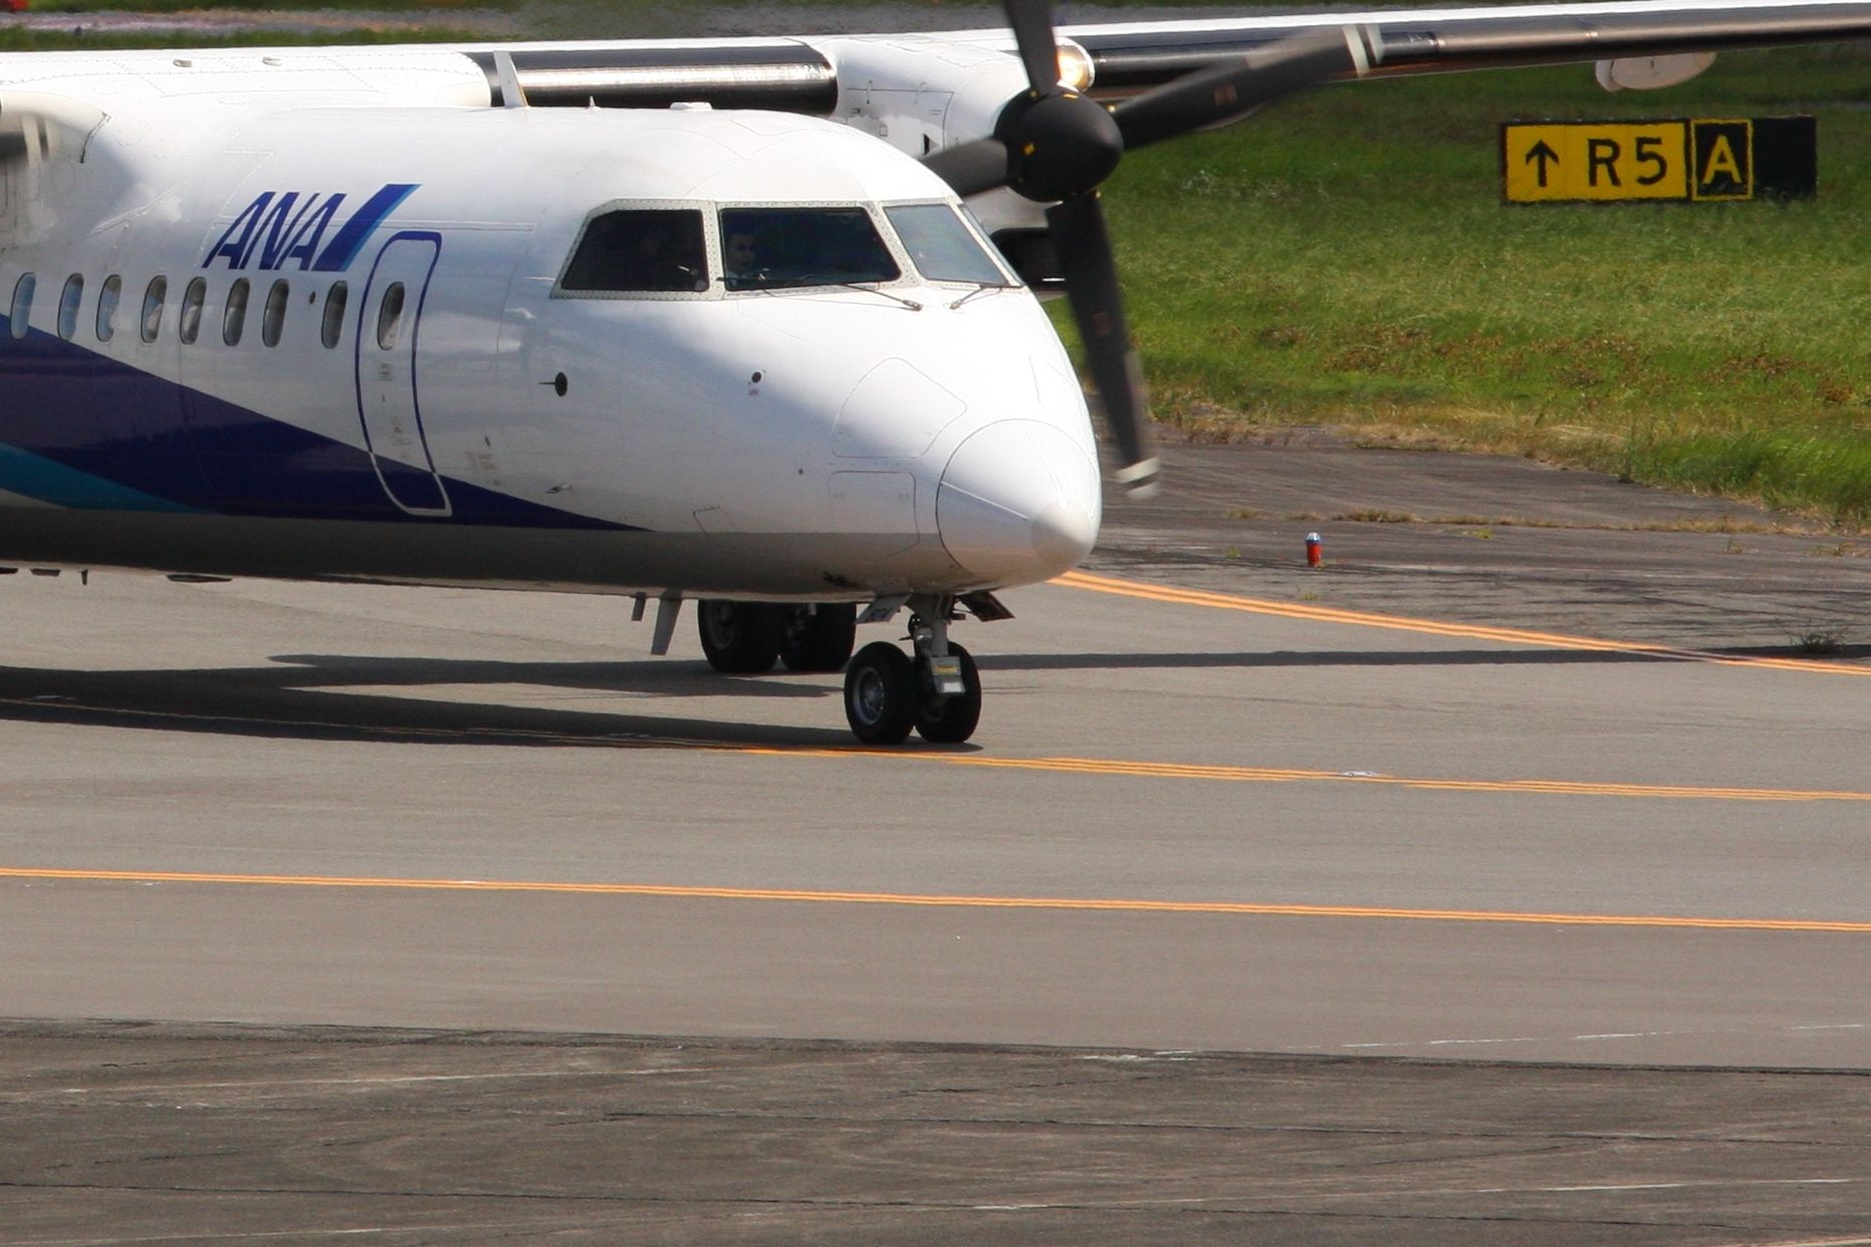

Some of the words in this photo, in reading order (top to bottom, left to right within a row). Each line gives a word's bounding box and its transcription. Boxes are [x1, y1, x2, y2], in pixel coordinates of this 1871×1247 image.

[1587, 136, 1668, 187] R5
[1701, 134, 1742, 185] A
[201, 191, 347, 272] ANA
